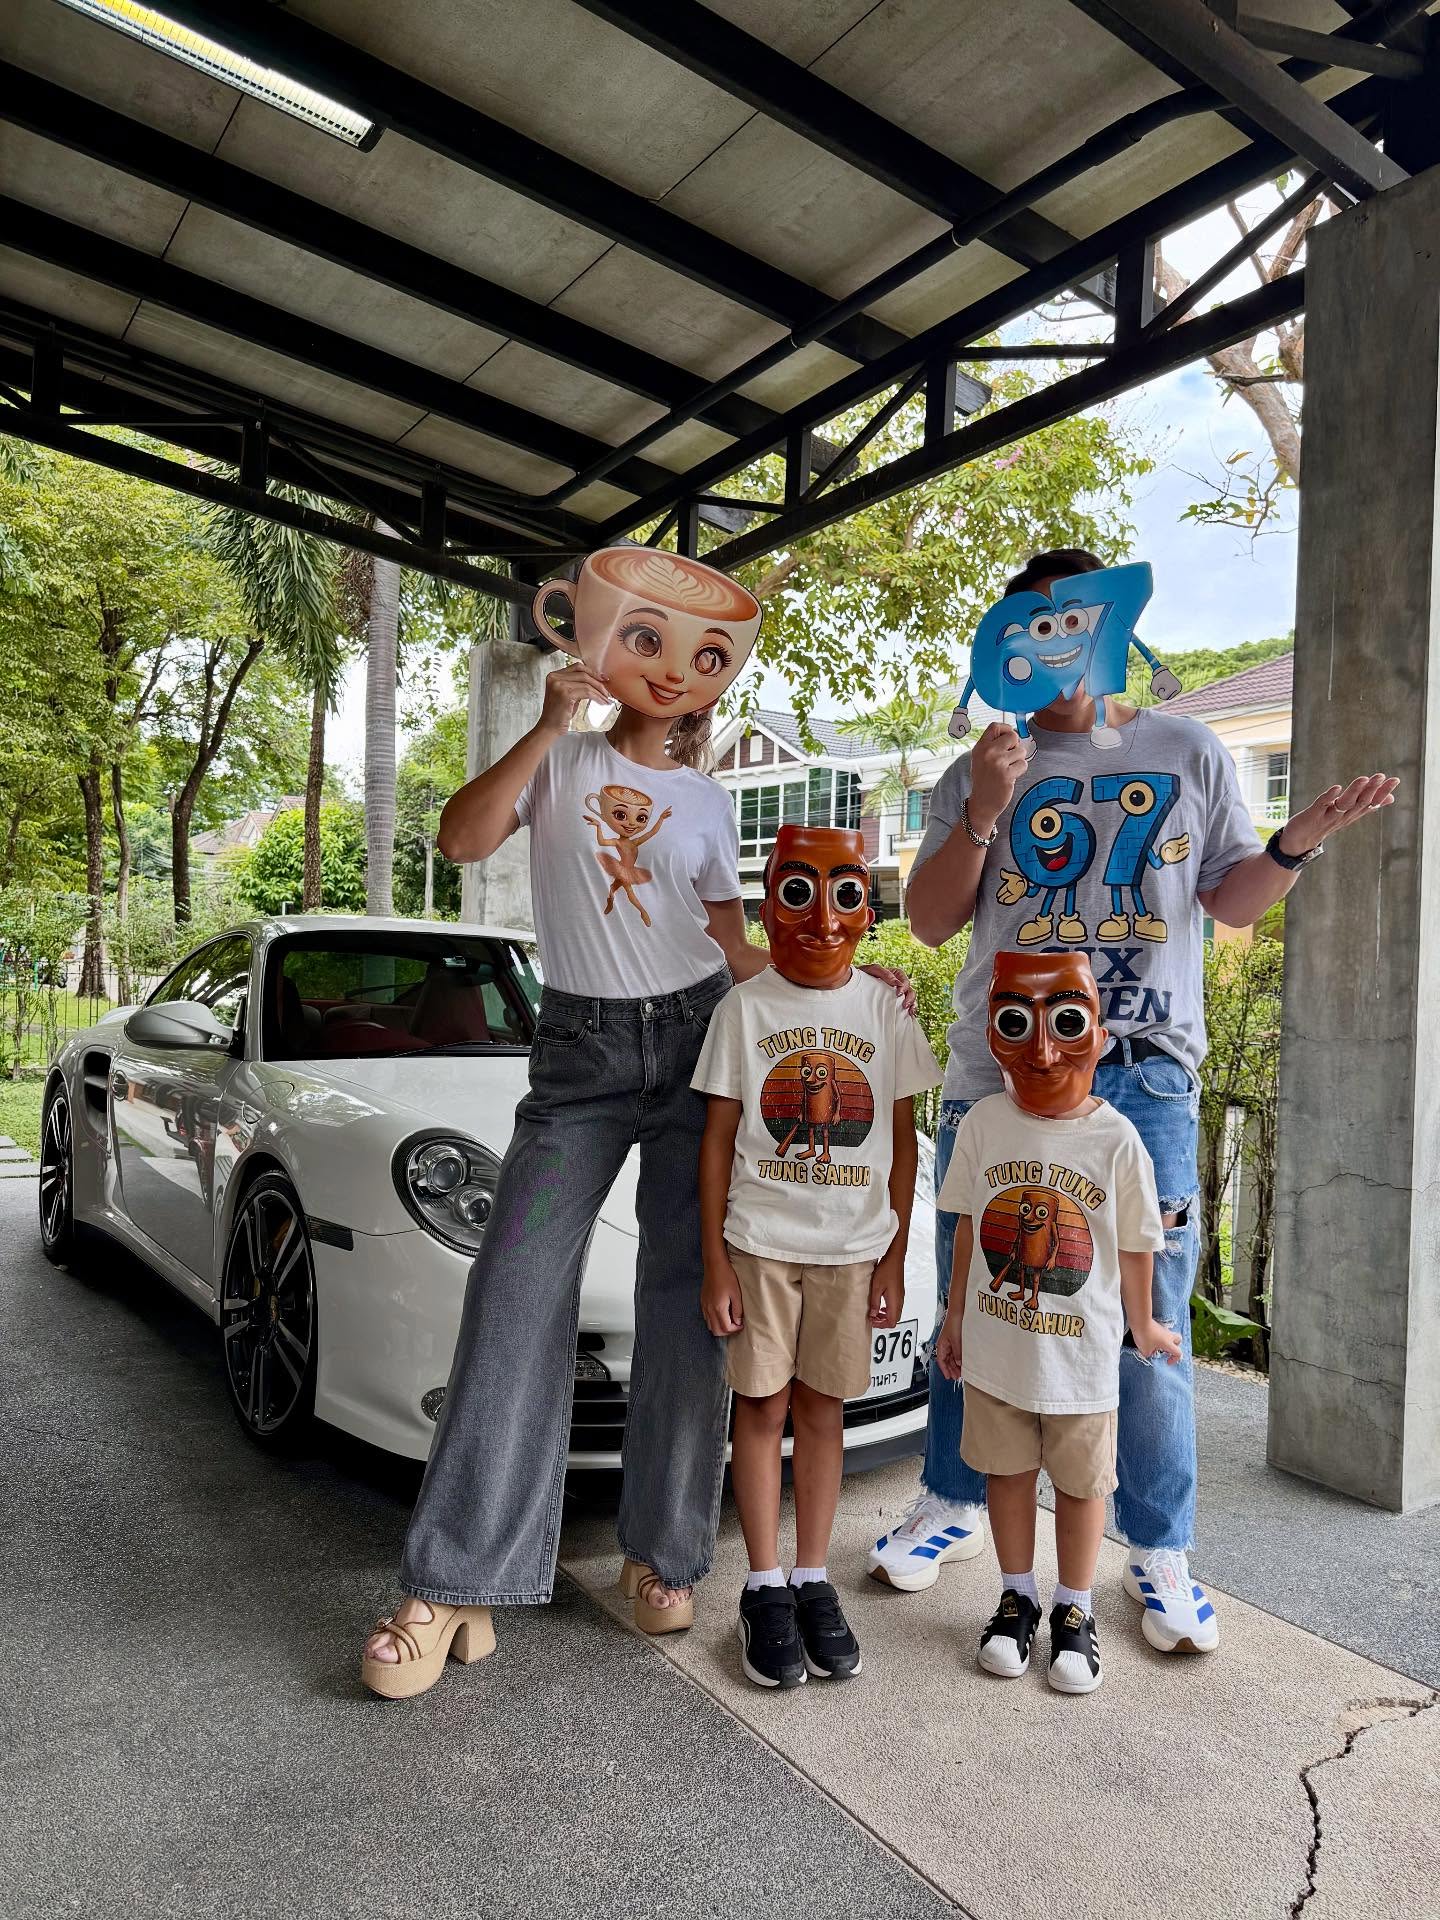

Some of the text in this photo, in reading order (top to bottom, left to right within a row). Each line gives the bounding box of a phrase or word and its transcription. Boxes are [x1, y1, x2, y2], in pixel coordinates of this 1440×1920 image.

[1010, 772, 1180, 889] 67
[757, 1027, 876, 1063] TUNG TUNG
[758, 1160, 871, 1187] TUNG SAHUR
[984, 1161, 1107, 1211] TUNG TUNG
[977, 1290, 1085, 1337] TUNG SAHUR
[873, 1330, 913, 1364] 976
[871, 1372, 898, 1388] านคร
